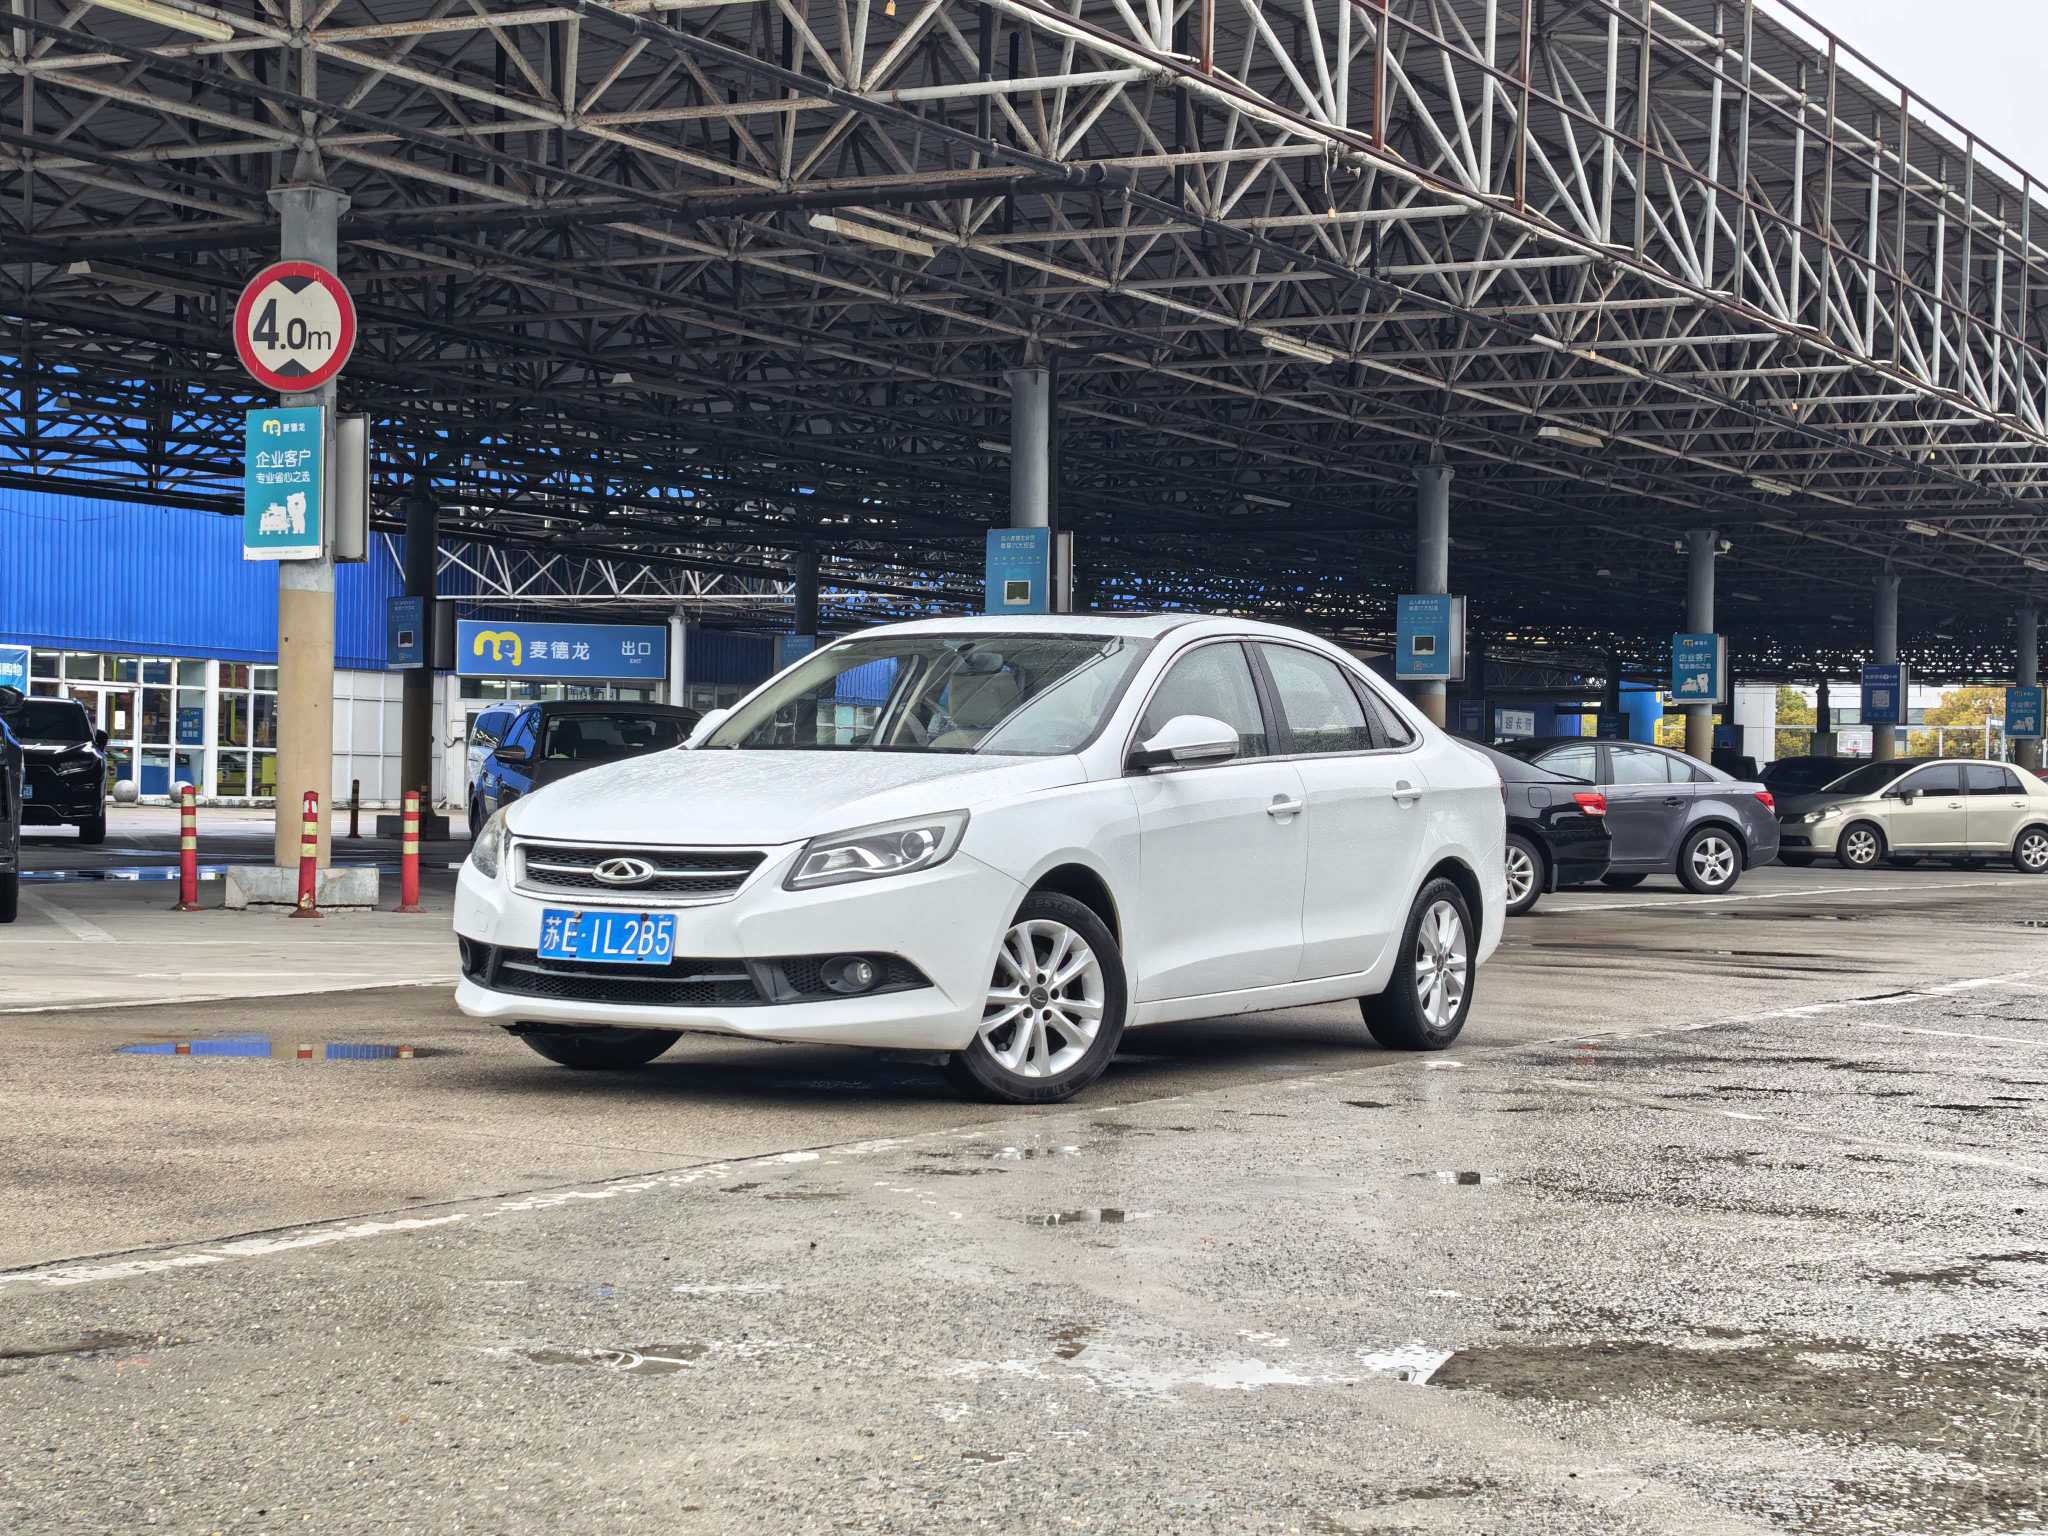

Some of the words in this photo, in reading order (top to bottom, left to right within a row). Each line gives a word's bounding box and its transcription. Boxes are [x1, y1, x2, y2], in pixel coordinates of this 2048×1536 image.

[253, 299, 331, 350] 4.0m
[256, 449, 311, 468] 企业客户
[529, 640, 590, 660] 麦德龙
[622, 641, 651, 656] 出口
